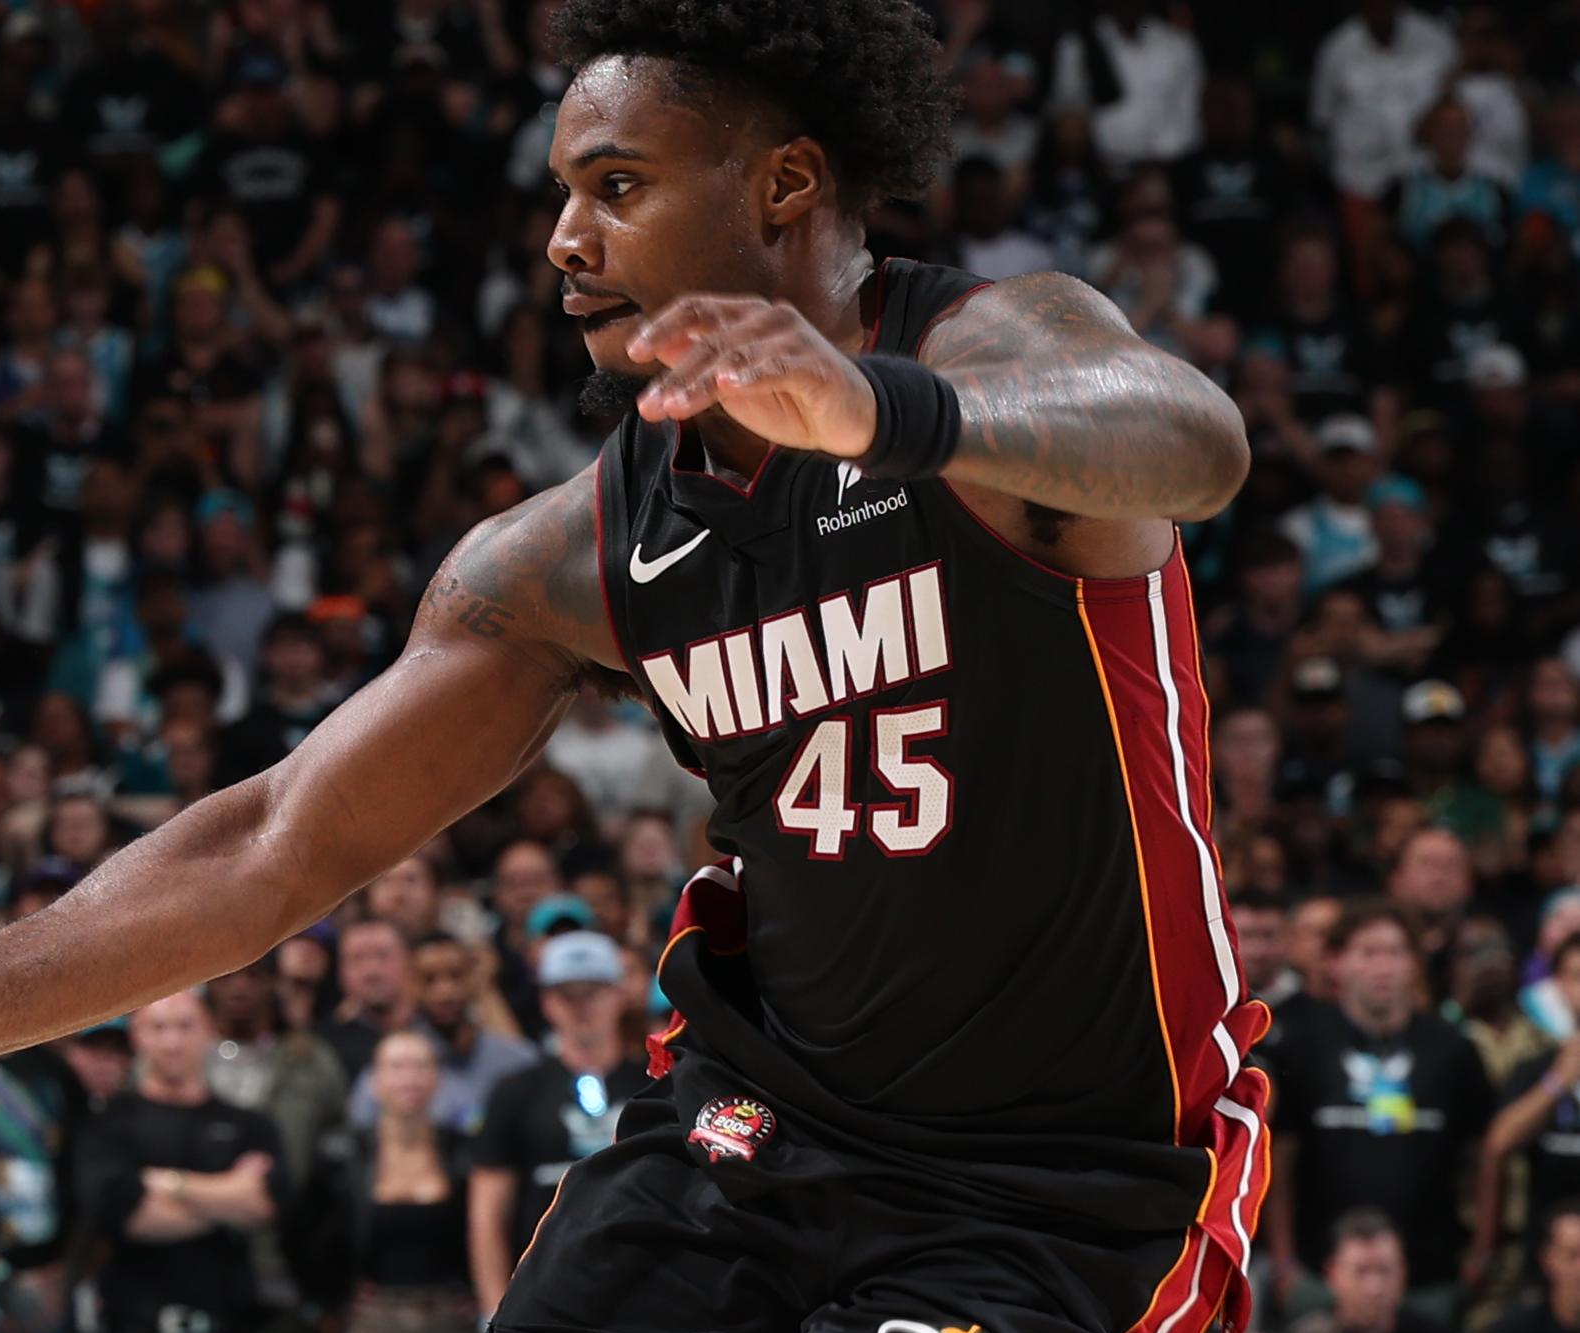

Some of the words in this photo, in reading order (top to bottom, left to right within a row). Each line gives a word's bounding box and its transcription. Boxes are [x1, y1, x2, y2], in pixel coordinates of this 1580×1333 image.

[816, 487, 908, 536] Robinhood
[638, 560, 953, 742] MIAMI
[773, 700, 954, 861] 45
[714, 1115, 753, 1137] 2006
